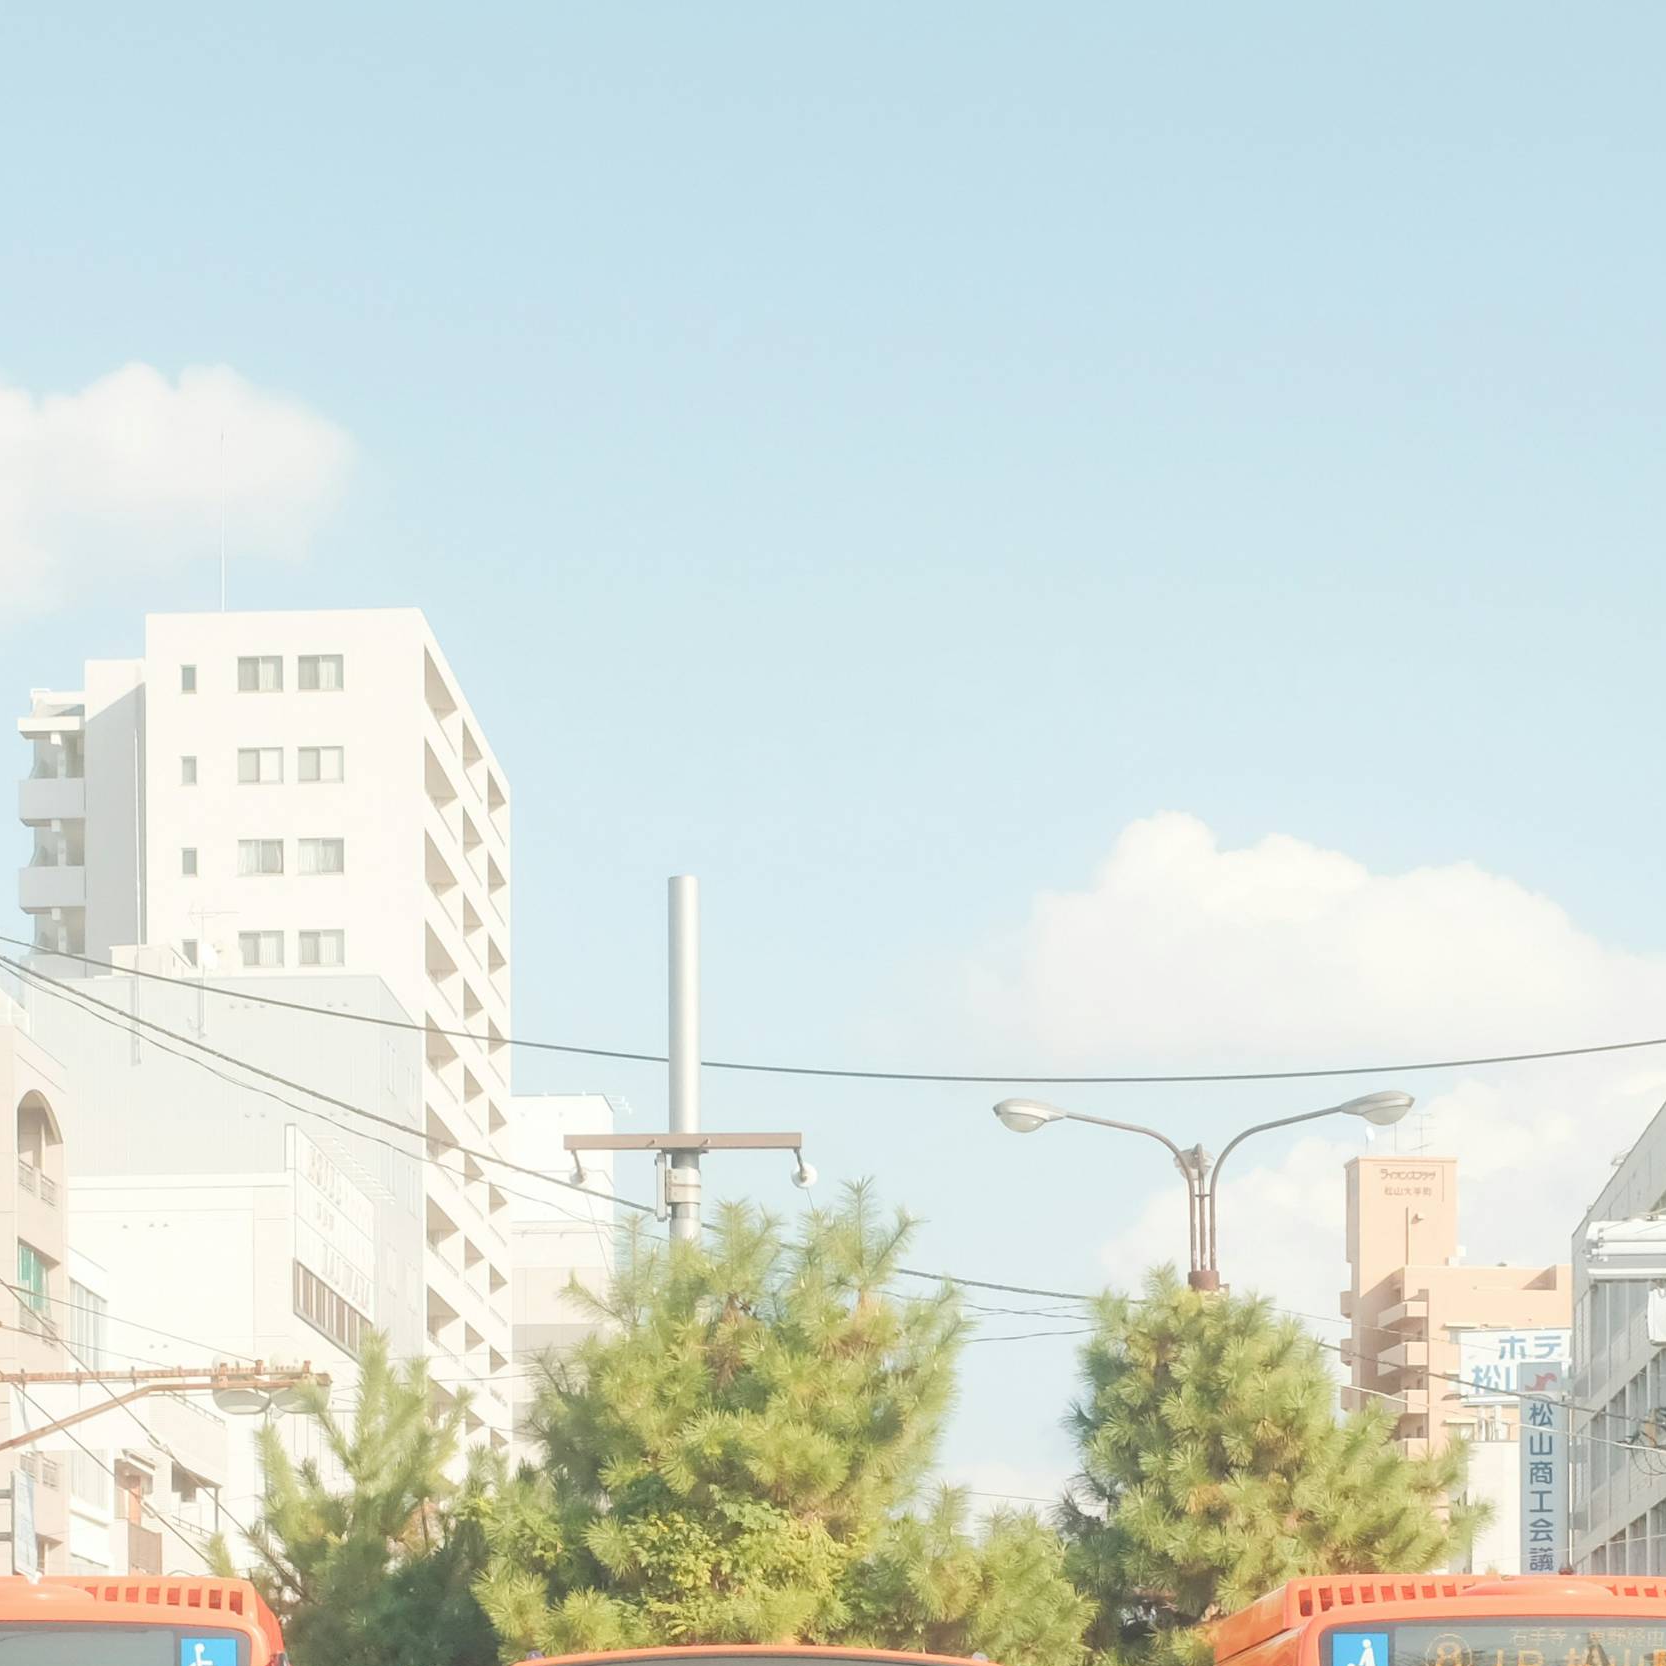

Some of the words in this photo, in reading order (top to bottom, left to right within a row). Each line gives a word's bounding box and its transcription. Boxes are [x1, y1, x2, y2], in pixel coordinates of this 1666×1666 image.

[1528, 1401, 1554, 1573] 松山商工会議
